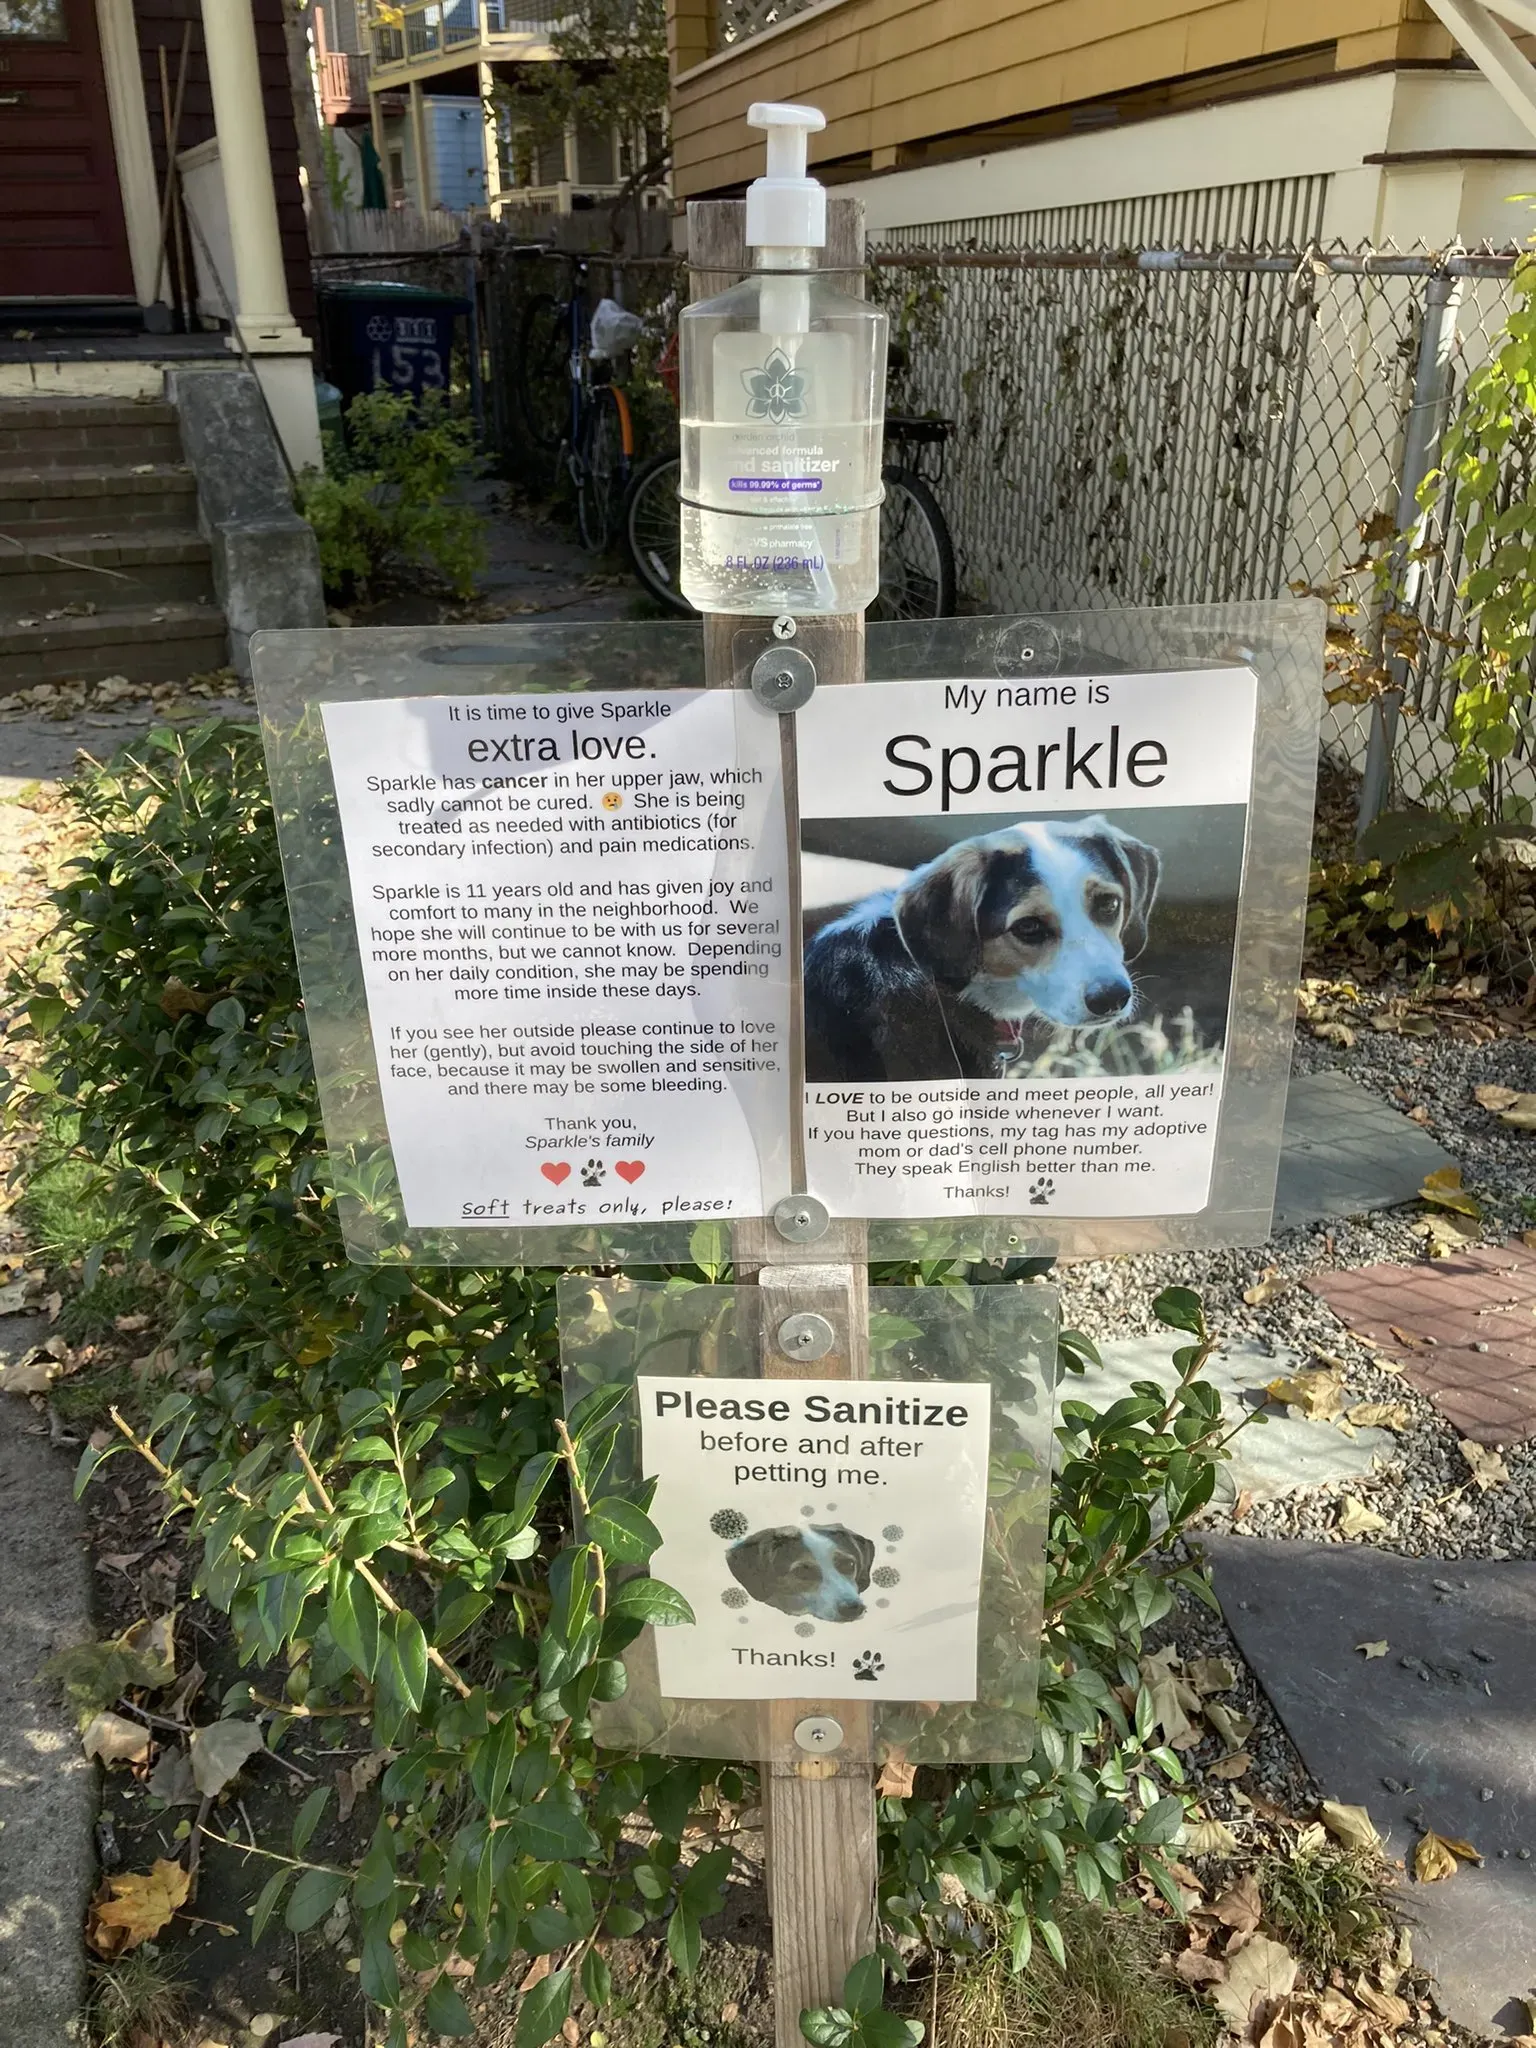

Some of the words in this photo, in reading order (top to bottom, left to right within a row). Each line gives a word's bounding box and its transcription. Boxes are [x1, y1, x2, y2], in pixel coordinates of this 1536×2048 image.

[782, 445, 824, 456] formula
[761, 457, 840, 472] sanitizer
[731, 480, 748, 489] kills
[749, 480, 779, 489] 99.99%
[781, 480, 790, 488] of
[769, 538, 813, 549] pharmacy
[726, 555, 733, 569] 8
[754, 556, 769, 570] OZ
[772, 556, 799, 572] (236
[802, 556, 824, 571] mL)
[945, 685, 987, 715] My
[997, 686, 1076, 707] name
[1088, 679, 1109, 704] is
[449, 706, 461, 721] It
[466, 705, 481, 721] is
[487, 704, 526, 720] time
[532, 705, 550, 719] to
[557, 703, 594, 722] give
[601, 701, 671, 721] Sparkle
[468, 734, 561, 764] extra
[572, 729, 656, 760] love.
[883, 725, 1168, 812] Sparkle
[367, 774, 436, 794] Sparkle
[442, 774, 476, 790] has
[481, 774, 548, 789] cancer
[554, 772, 569, 788] in
[576, 772, 605, 787] her
[612, 774, 663, 789] upper
[669, 770, 704, 789] jaw,
[709, 767, 763, 784] which
[387, 797, 435, 816] sadly
[440, 796, 503, 812] cannot
[508, 795, 530, 811] be
[537, 794, 592, 810] cured.
[634, 793, 669, 808] She
[676, 792, 690, 807] is
[696, 790, 745, 810] being
[398, 817, 462, 835] treated
[469, 821, 490, 833] as
[496, 816, 563, 833] needed
[568, 816, 605, 831] with
[612, 814, 701, 831] antibiotics
[707, 813, 737, 832] (for
[372, 841, 466, 858] secondary
[472, 839, 553, 857] infection)
[560, 838, 593, 854] and
[599, 837, 636, 856] pain
[643, 835, 754, 853] medications.
[373, 884, 440, 902] Sparkle
[446, 883, 461, 898] is
[467, 884, 487, 898] 11
[492, 885, 541, 900] years
[547, 881, 573, 896] old
[580, 881, 612, 896] and
[618, 880, 650, 895] has
[656, 879, 703, 897] given
[707, 878, 735, 897] joy
[740, 877, 772, 893] and
[389, 905, 457, 920] comfort
[461, 906, 478, 919] to
[484, 907, 532, 921] many
[538, 903, 553, 917] in
[559, 902, 586, 917] the
[593, 899, 718, 919] neighborhood.
[729, 900, 758, 914] We
[455, 989, 498, 1000] more
[504, 985, 541, 999] time
[547, 984, 597, 998] inside
[602, 983, 650, 997] these
[656, 982, 700, 1000] days.
[391, 1064, 431, 1079] face,
[437, 1064, 509, 1077] because
[515, 1062, 525, 1076] it
[530, 1065, 566, 1078] may
[571, 1061, 592, 1074] be
[598, 1060, 660, 1074] swollen
[666, 1059, 696, 1073] and
[703, 1058, 780, 1072] sensitive,
[448, 1082, 479, 1095] and
[484, 1082, 527, 1095] there
[533, 1083, 569, 1097] may
[574, 1080, 595, 1093] be
[601, 1082, 646, 1092] some
[652, 1078, 727, 1094] bleeding.
[815, 1093, 864, 1104] LOVE
[870, 1092, 885, 1104] to
[892, 1091, 912, 1104] be
[918, 1088, 980, 1103] outside
[986, 1088, 1019, 1101] and
[1025, 1088, 1069, 1101] meet
[1075, 1086, 1138, 1102] people,
[1145, 1084, 1164, 1098] all
[1170, 1083, 1213, 1101] year!
[544, 1116, 597, 1130] Thank
[601, 1119, 636, 1132] you,
[847, 1110, 875, 1122] But
[892, 1109, 927, 1122] also
[932, 1107, 953, 1124] go
[960, 1106, 1010, 1119] inside
[1015, 1106, 1101, 1119] whenever
[1118, 1105, 1163, 1118] want.
[525, 1135, 600, 1151] Sparkle's
[606, 1133, 655, 1149] family
[809, 1127, 818, 1139] If
[824, 1130, 854, 1142] you
[861, 1127, 901, 1140] have
[907, 1124, 993, 1142] questions,
[1001, 1127, 1027, 1140] my
[1032, 1126, 1058, 1140] tag
[1065, 1124, 1096, 1137] has
[1102, 1126, 1129, 1139] my
[1134, 1121, 1207, 1138] adoptive
[859, 1148, 900, 1158] mom
[906, 1147, 923, 1157] or
[929, 1143, 973, 1158] dad's
[979, 1142, 1007, 1156] cell
[1014, 1142, 1067, 1158] phone
[1073, 1142, 1142, 1155] number.
[854, 1162, 897, 1178] They
[902, 1161, 952, 1178] speak
[959, 1160, 1020, 1175] English
[1026, 1160, 1076, 1173] better
[1081, 1160, 1118, 1173] than
[1125, 1162, 1155, 1172] me.
[943, 1185, 1009, 1199] Thanks!
[461, 1199, 510, 1219] Soft
[523, 1198, 586, 1215] treats
[599, 1197, 647, 1216] only,
[662, 1195, 732, 1215] please!
[656, 1391, 790, 1421] Please
[804, 1395, 968, 1427] Sanitize
[701, 1430, 788, 1453] before
[798, 1435, 849, 1455] and
[860, 1436, 923, 1457] after
[735, 1464, 826, 1488] petting
[838, 1469, 887, 1485] me.
[731, 1648, 835, 1667] Thanks!
